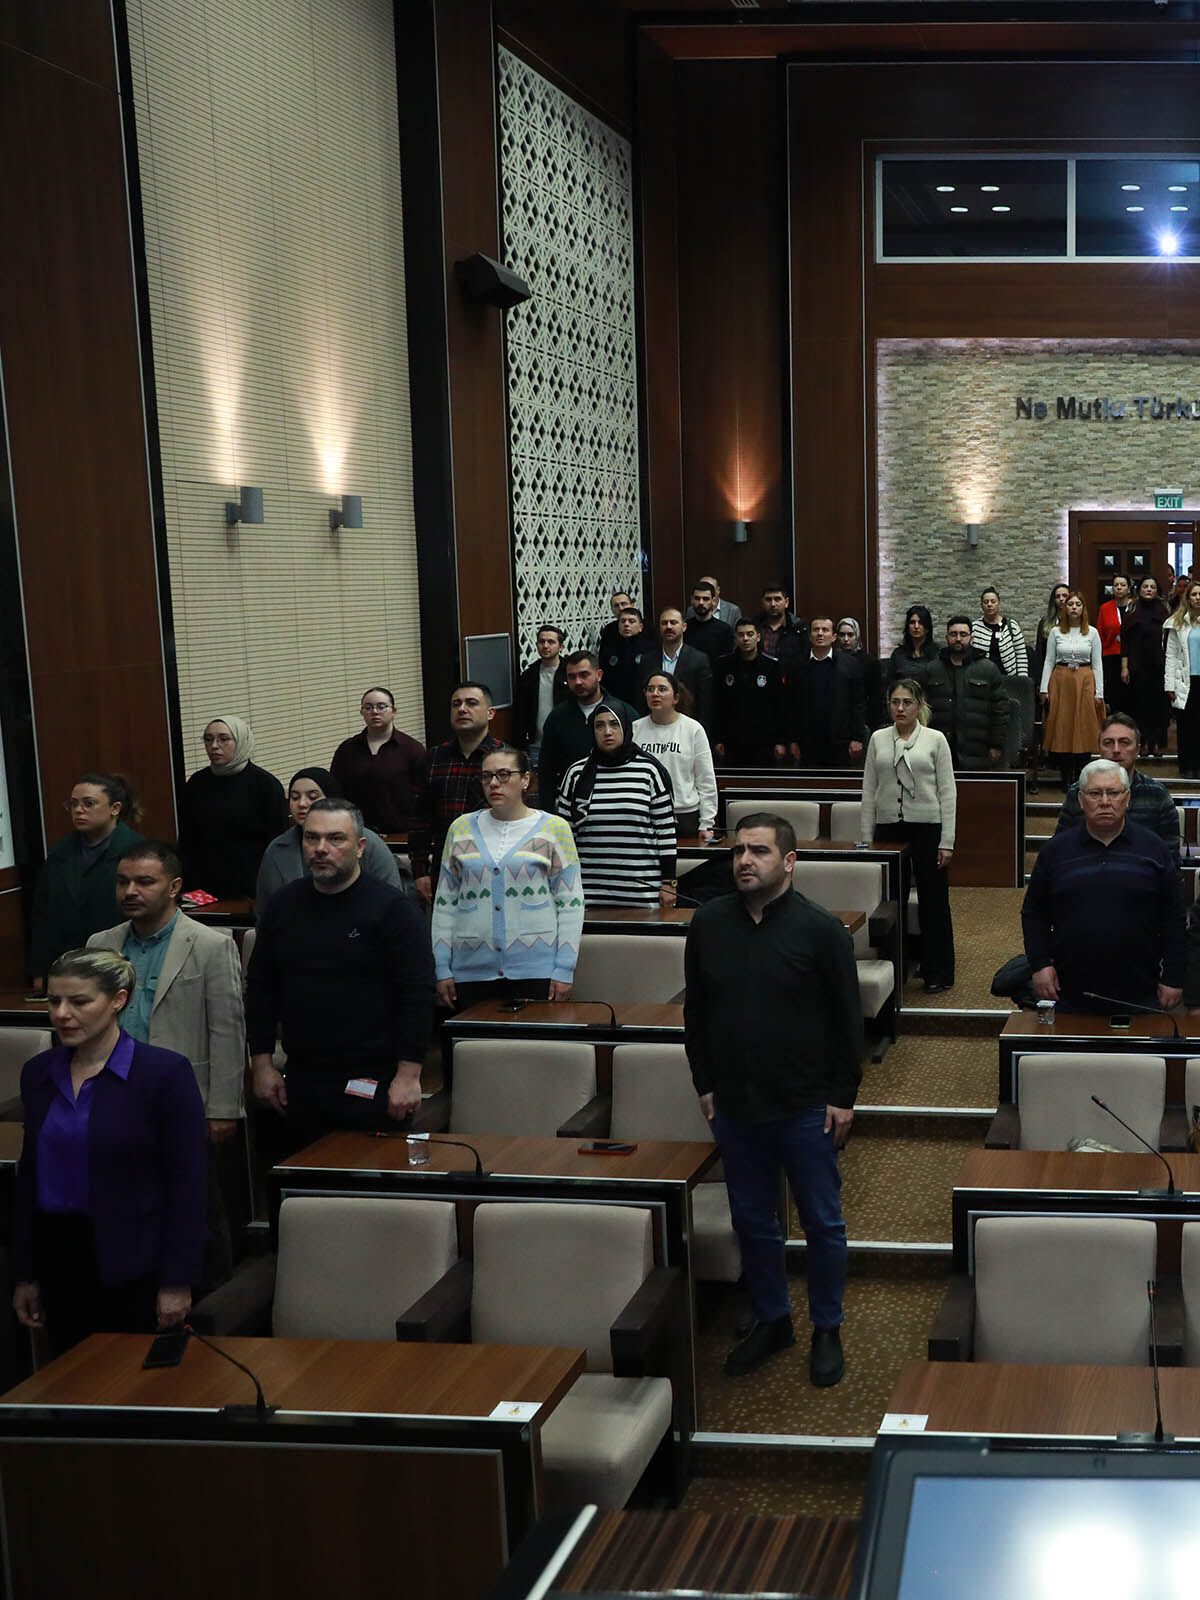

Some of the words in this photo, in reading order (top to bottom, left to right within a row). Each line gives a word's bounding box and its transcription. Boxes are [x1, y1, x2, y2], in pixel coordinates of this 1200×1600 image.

[1016, 397, 1048, 420] Ne
[1056, 397, 1125, 420] Mutlu
[1157, 495, 1179, 508] EXIT
